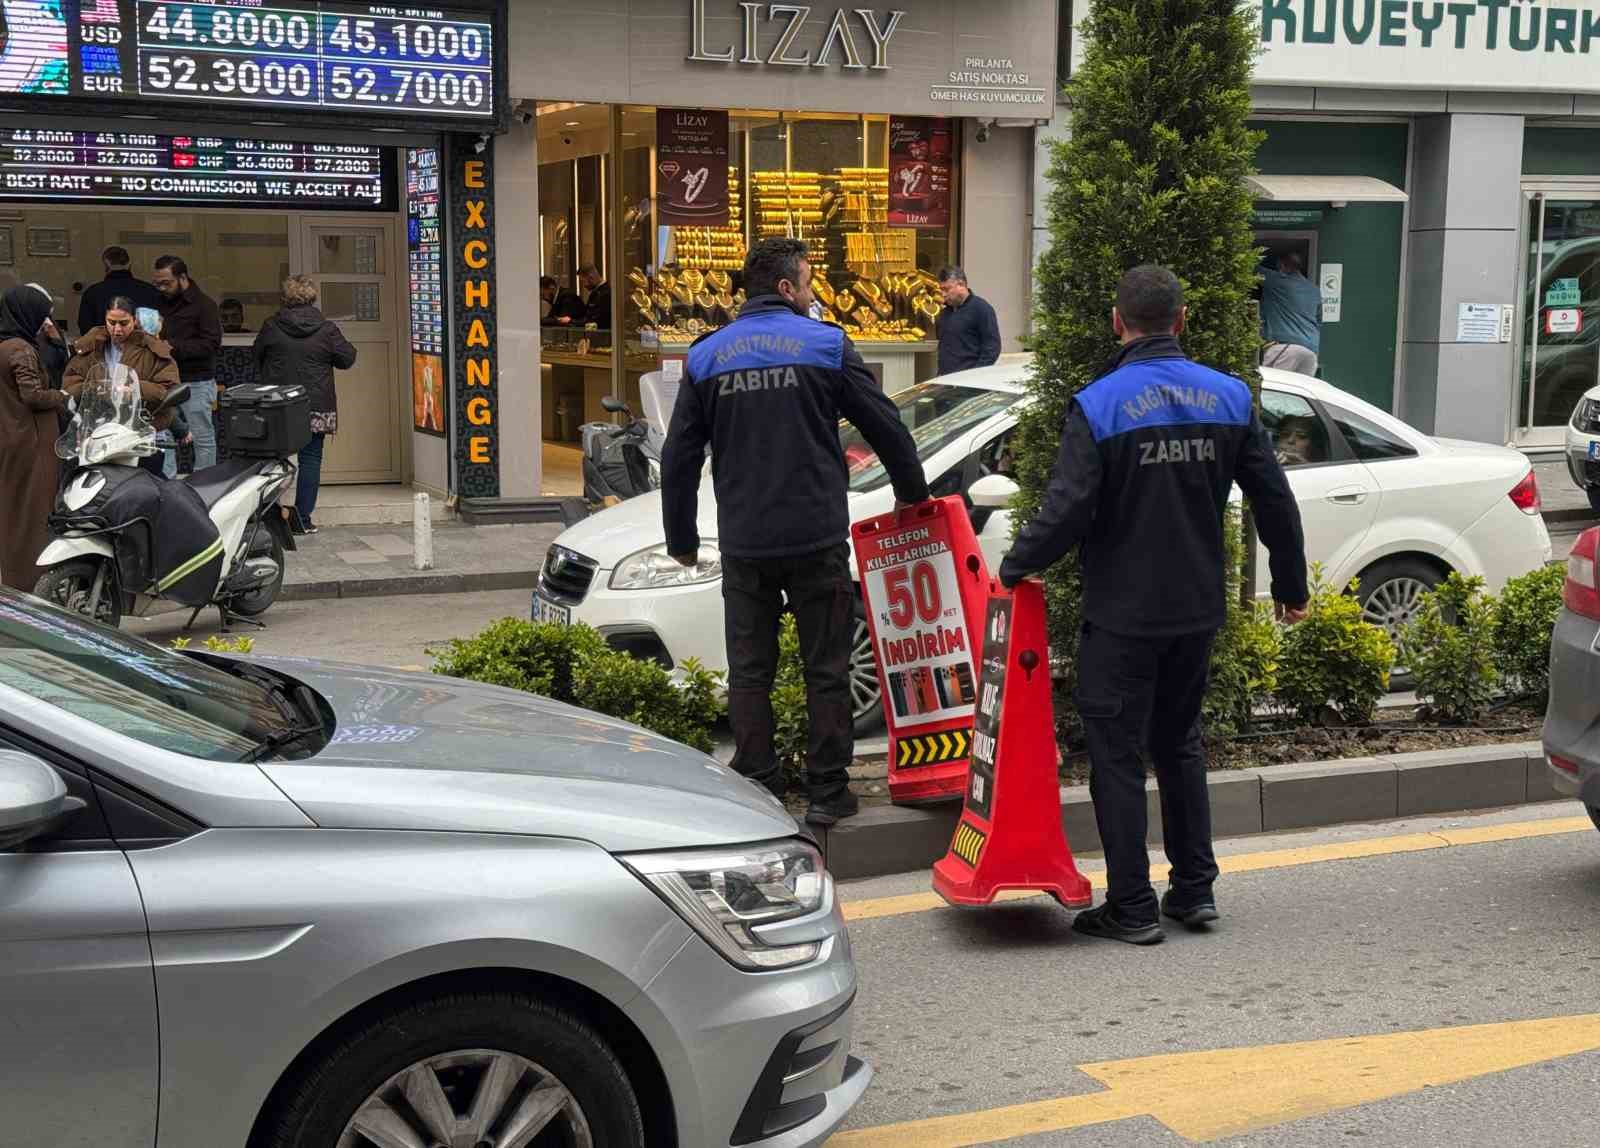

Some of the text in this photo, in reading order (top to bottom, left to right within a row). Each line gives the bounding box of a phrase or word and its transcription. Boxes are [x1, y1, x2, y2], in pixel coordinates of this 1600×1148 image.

[80, 25, 122, 44] USD
[146, 6, 482, 60] 44.8000 45.1000
[688, 0, 906, 70] LIZAY
[83, 75, 123, 92] EUR
[149, 56, 483, 106] 52.3000 52.7000
[198, 156, 224, 168] CHF
[6, 174, 46, 188] BEST
[50, 175, 91, 189] RATE
[121, 177, 147, 191] NO
[150, 178, 258, 195] COMMISSION
[265, 181, 292, 195] WE
[294, 182, 350, 197] ACCEPT
[463, 160, 492, 464] EXCHANGE
[718, 366, 799, 397] ZABITA
[1138, 438, 1216, 466] ZABITA
[877, 528, 929, 550] TELEFON
[867, 541, 948, 570] KILIFLARINDA
[883, 560, 943, 631] 50
[882, 624, 966, 667] İNDİRİM
